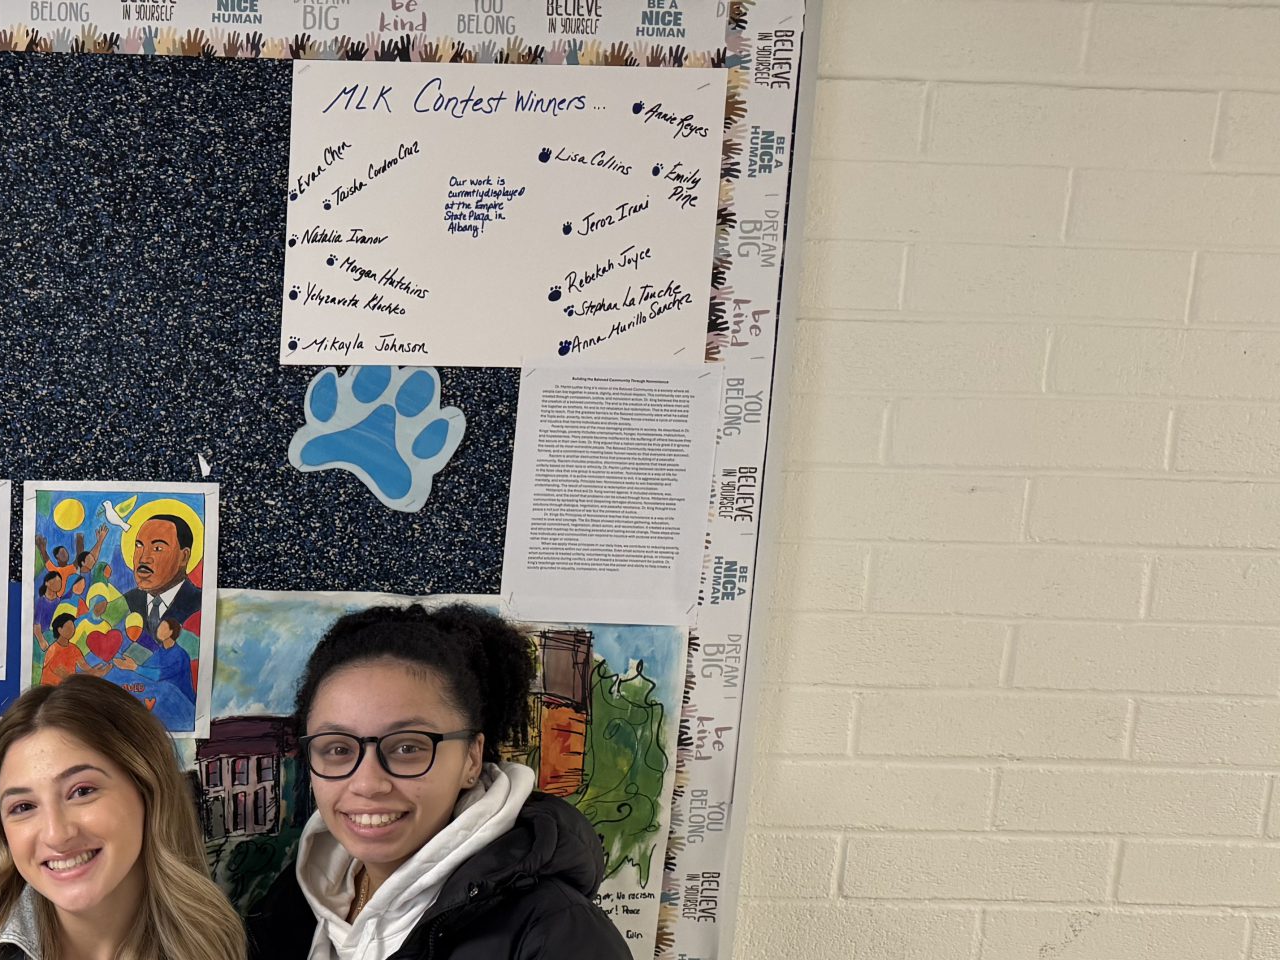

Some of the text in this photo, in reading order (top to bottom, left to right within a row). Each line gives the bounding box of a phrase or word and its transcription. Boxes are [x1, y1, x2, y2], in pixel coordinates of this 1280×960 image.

[30, 1, 90, 21] BELONG
[122, 4, 174, 22] IN YOURSELF
[211, 13, 263, 24] HUMAN
[216, 0, 259, 12] NICE
[303, 5, 340, 31] BIG
[391, 0, 417, 12] be
[546, 0, 602, 17] BELIEVE
[641, 11, 682, 27] NICE
[647, 0, 678, 9] BE A
[380, 11, 427, 33] kind
[458, 14, 516, 35] BELONG
[548, 18, 600, 35] IN YOURSELF
[636, 26, 686, 38] HUMAN
[754, 32, 773, 87] IN YOURSELF
[770, 29, 795, 90] BELIEVE
[322, 83, 392, 113] MLK
[414, 77, 507, 118] Contest
[645, 103, 709, 139] Annie Reyes
[555, 147, 632, 175] Lisa Collins
[747, 125, 761, 178] HUMAN
[758, 130, 775, 174] NICE
[774, 136, 785, 169] BE A
[297, 141, 352, 195] Evan Chen
[331, 178, 367, 206] Taisha
[398, 141, 420, 160] Cruz
[449, 175, 506, 187] Our work is
[664, 161, 701, 190] Emily
[474, 201, 504, 213] Empire
[615, 195, 649, 222] Irani
[668, 185, 698, 209] Pine
[443, 210, 506, 222] State Plaza in
[301, 226, 389, 245] Natalia Ivanov
[737, 219, 763, 258] BIG
[760, 209, 780, 268] DREAM
[340, 257, 430, 299] Morgan Hutchins
[564, 245, 651, 293] Rebekah Joyce
[574, 298, 621, 316] Stephan
[730, 298, 752, 347] kind
[571, 293, 693, 353] Anna Murillo Sanchez
[749, 309, 771, 337] be
[301, 332, 429, 356] Mikayla Johnson
[723, 377, 745, 437] BELONG
[743, 390, 764, 424] YOU
[718, 468, 737, 520] IN YOURSELF
[733, 466, 758, 523] BELIEVE
[710, 555, 724, 605] HUMAN
[721, 560, 737, 601] NICE
[736, 565, 748, 596] BE A
[700, 643, 726, 679] BIG
[723, 634, 742, 689] DREAM
[694, 716, 715, 761] kind
[712, 726, 734, 752] be
[686, 789, 708, 844] BELONG
[706, 801, 727, 832] YOU
[628, 892, 655, 901] racism
[682, 873, 701, 921] IN YOURSELF
[697, 871, 721, 923] BELIEVE
